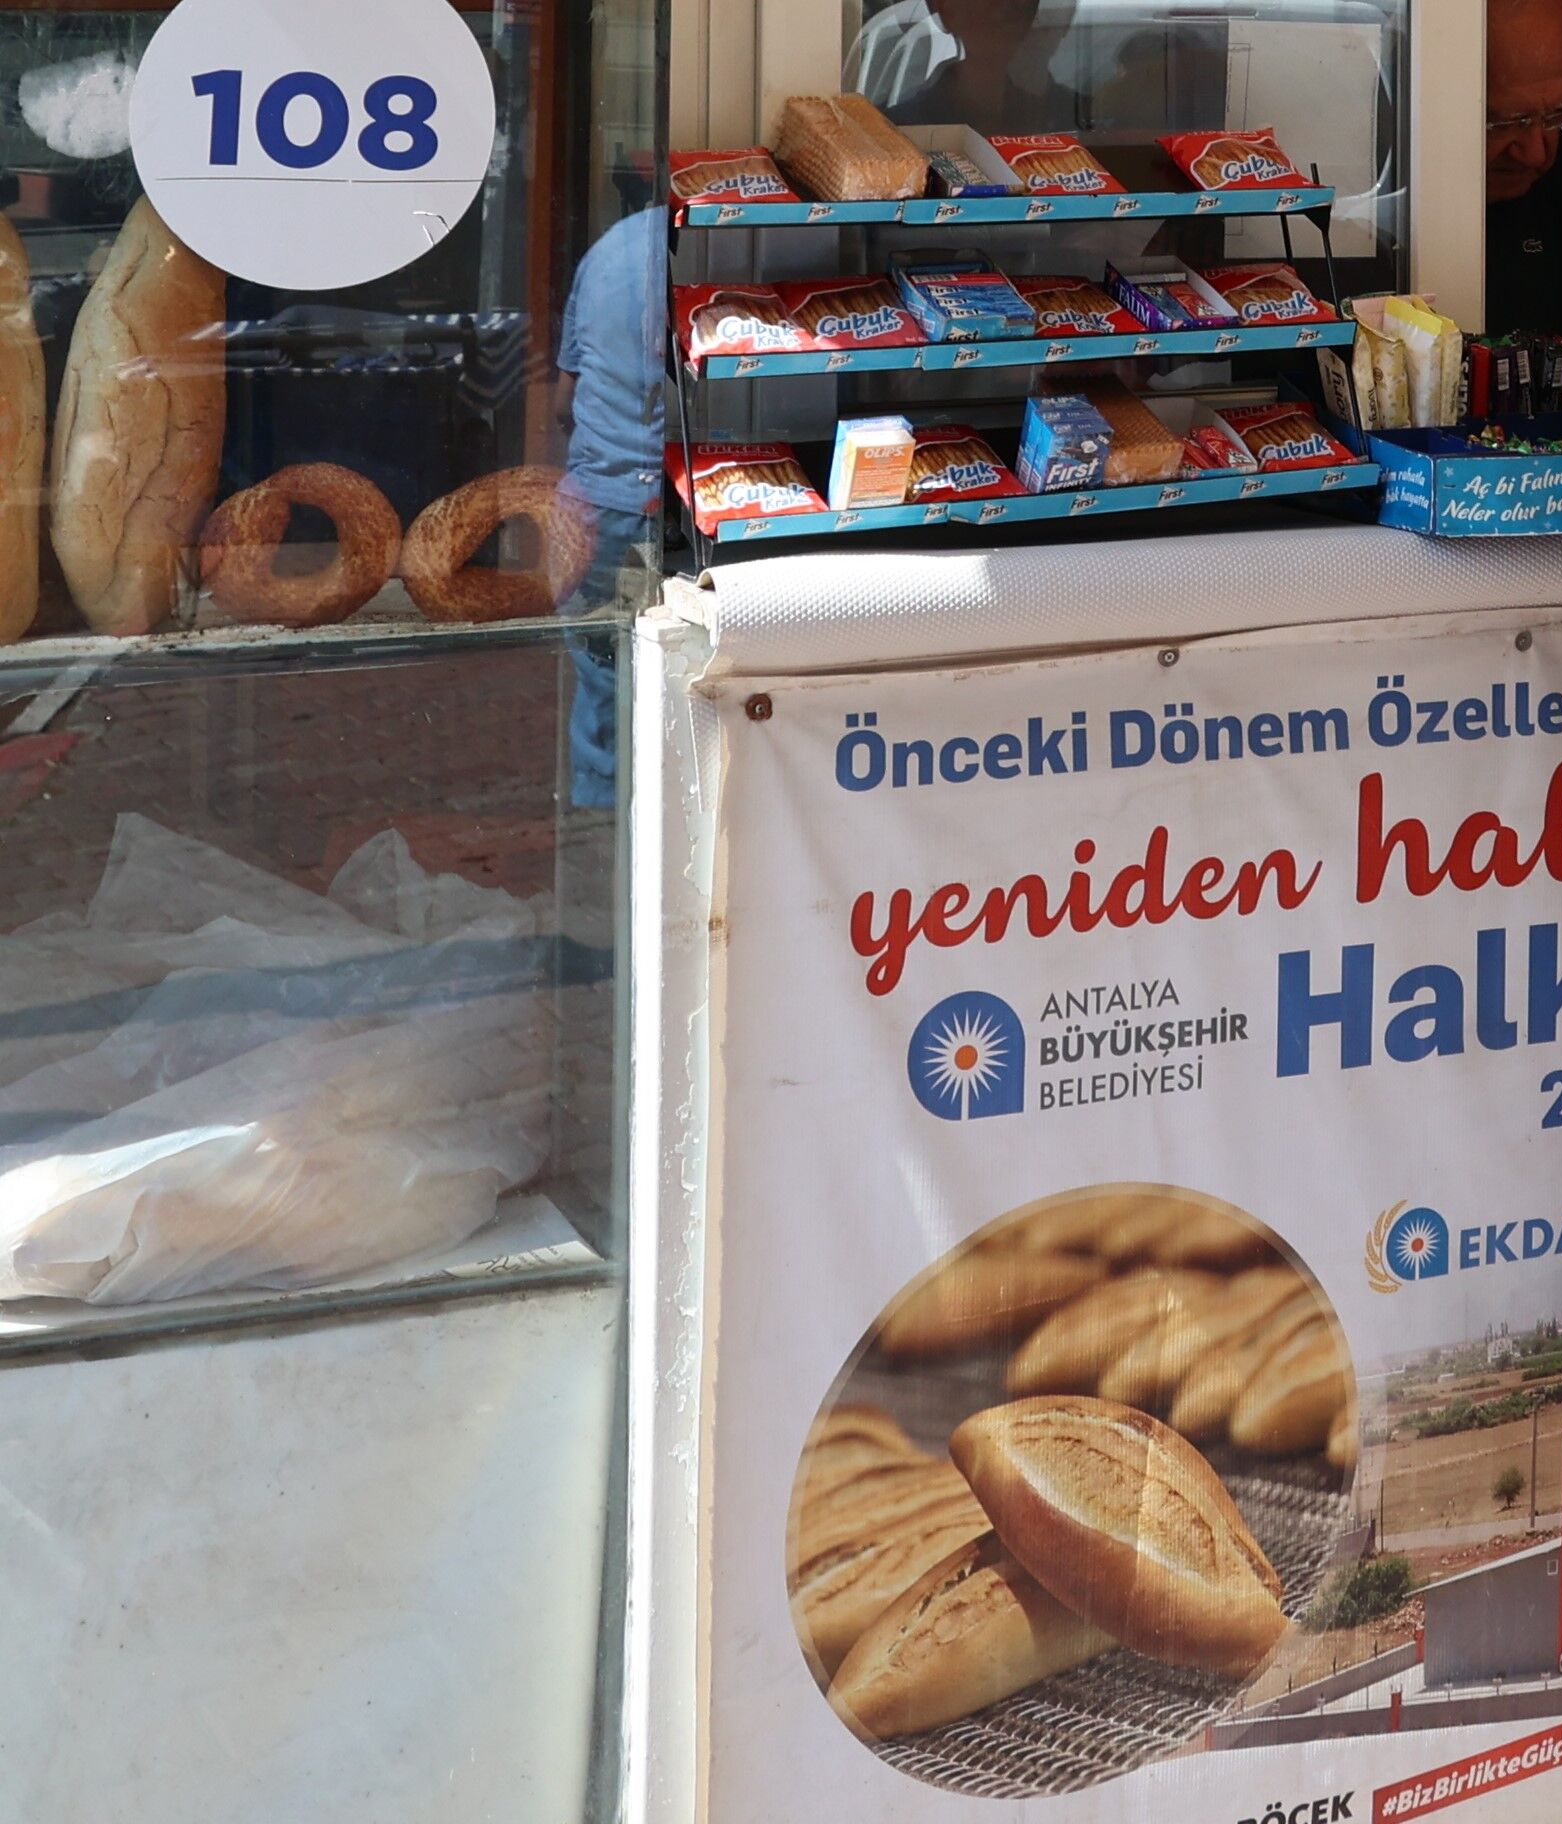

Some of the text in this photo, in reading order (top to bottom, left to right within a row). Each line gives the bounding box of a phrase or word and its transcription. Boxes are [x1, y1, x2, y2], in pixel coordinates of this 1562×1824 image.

[190, 68, 440, 172] 108
[819, 306, 898, 337] Çubuk
[855, 319, 901, 338] Kraker
[1046, 458, 1102, 483] First
[1463, 475, 1489, 499] Aç
[1495, 476, 1516, 496] bi
[1441, 498, 1496, 522] Neler
[1500, 497, 1541, 521] olur
[834, 711, 1088, 792] Önceki
[1109, 702, 1350, 769] Dönem
[849, 825, 1323, 996] yeniden
[1039, 977, 1180, 1023] ANTALYA
[1039, 1006, 1249, 1065] BÜYÜKŞEHİR
[1039, 1054, 1204, 1111] BELEDİYESİ
